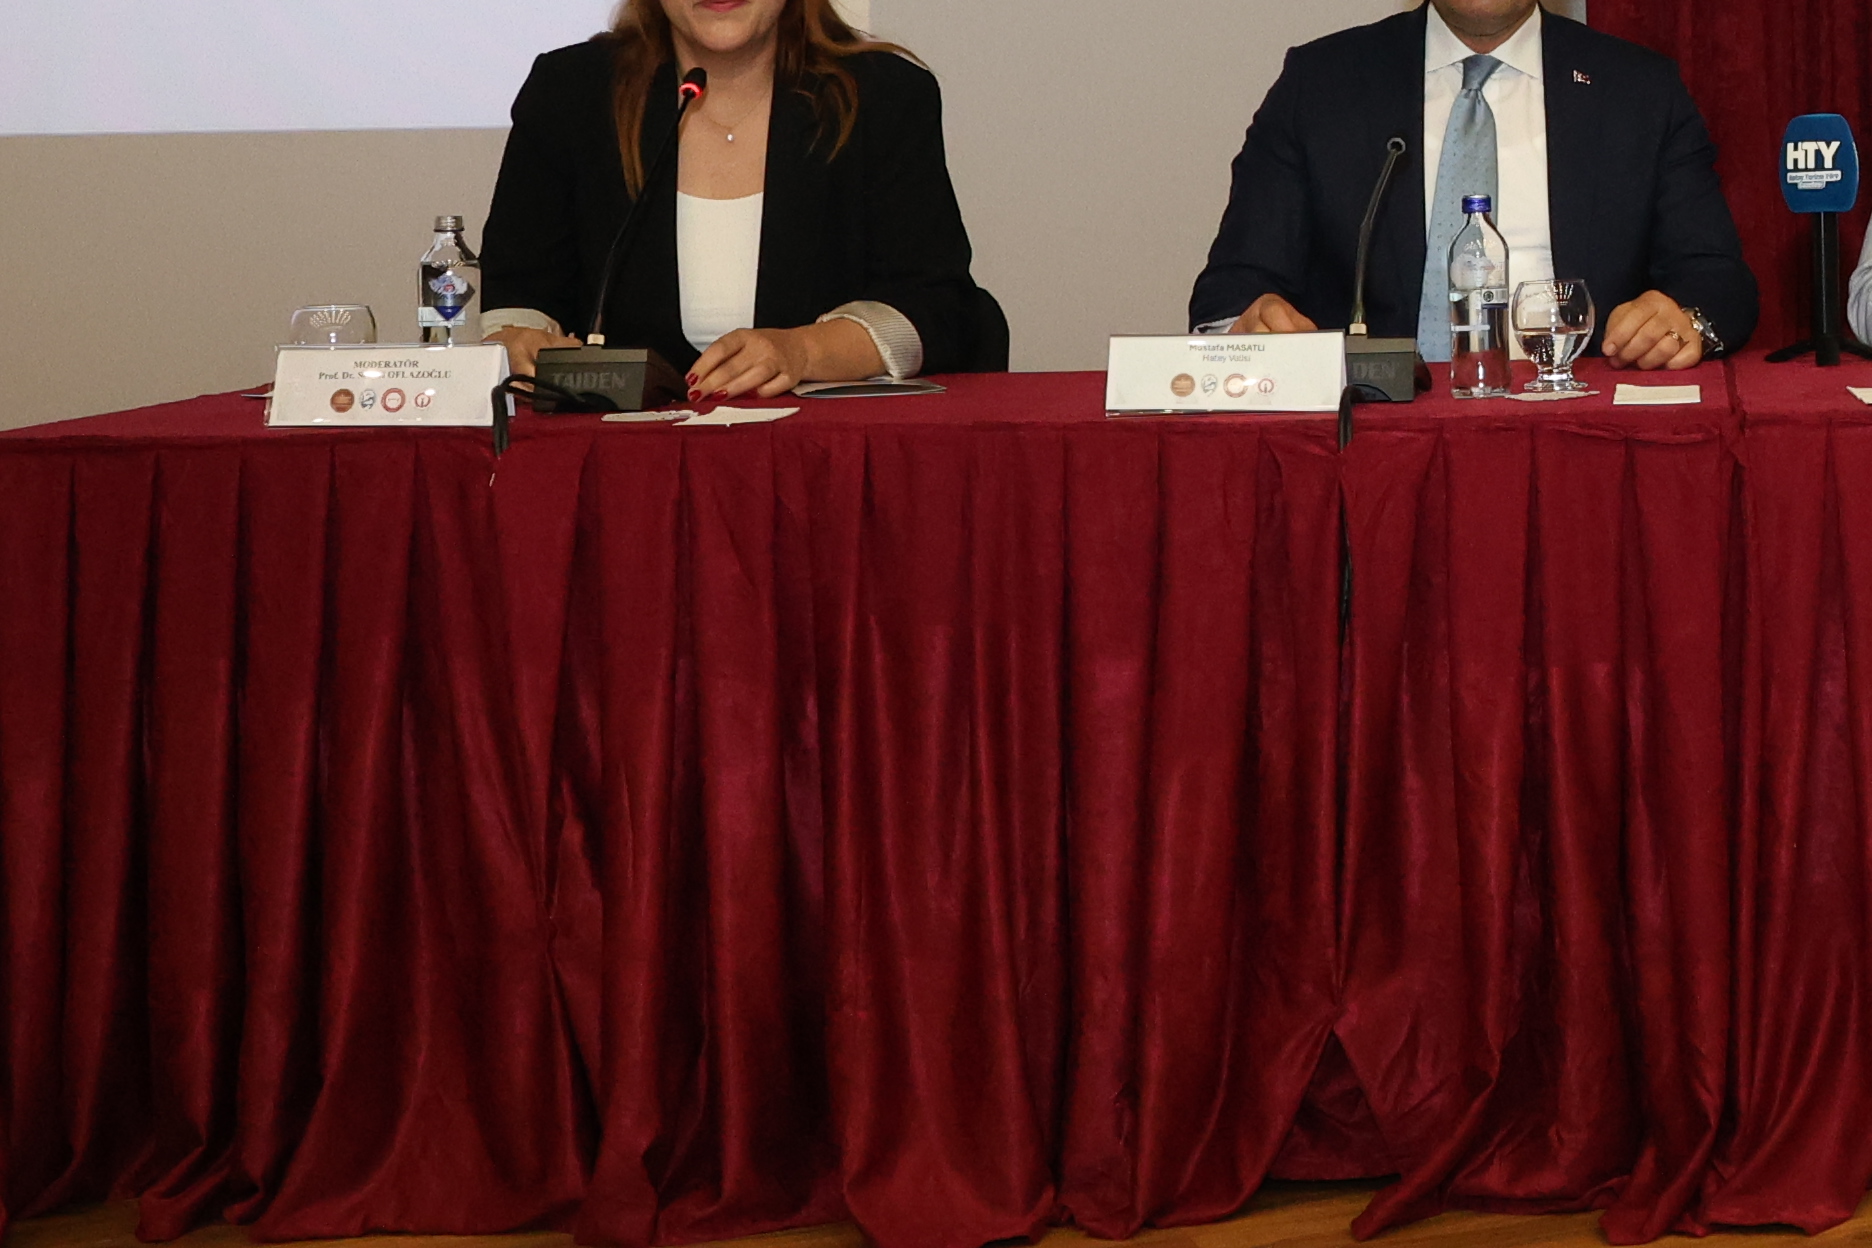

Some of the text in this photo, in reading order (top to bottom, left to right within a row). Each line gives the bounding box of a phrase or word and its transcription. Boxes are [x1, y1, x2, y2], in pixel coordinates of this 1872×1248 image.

[1786, 141, 1841, 170] HTY
[1189, 343, 1265, 352] Mustafa MASATLI
[341, 371, 355, 380] Dr.
[1352, 361, 1396, 379] DEN
[552, 372, 627, 390] TAIDEN
